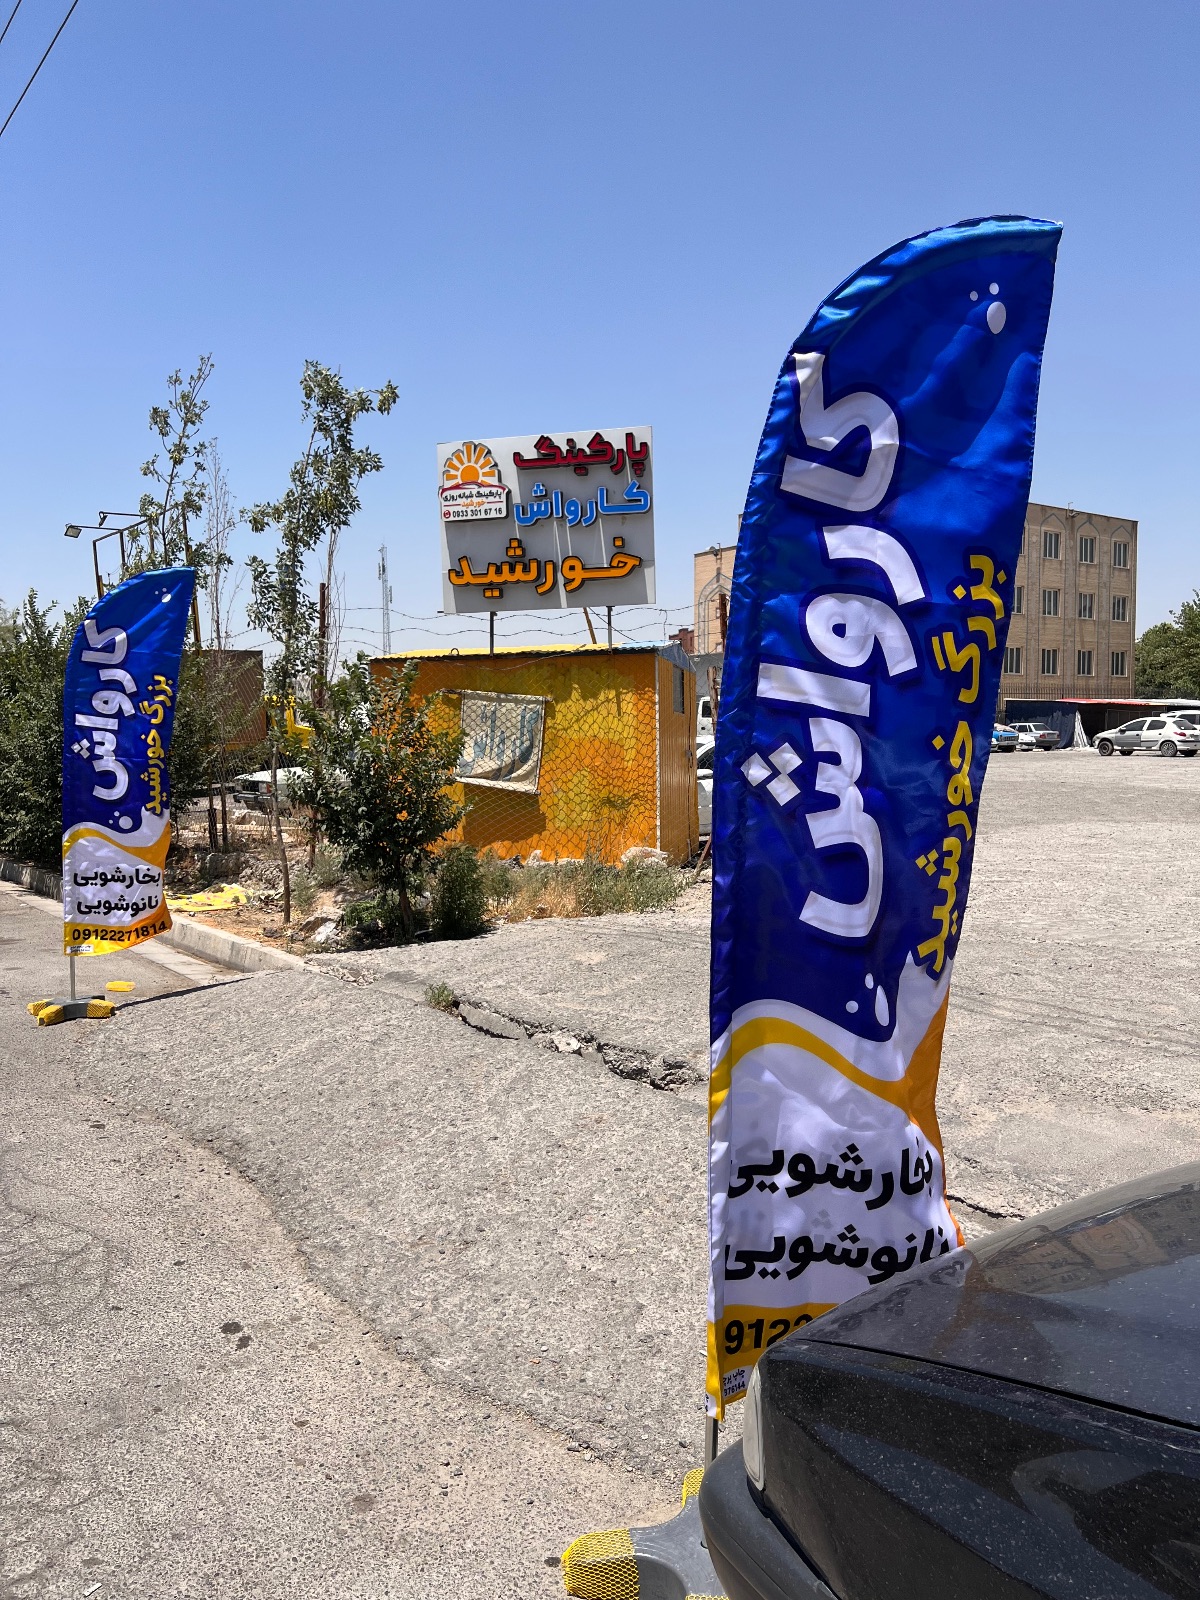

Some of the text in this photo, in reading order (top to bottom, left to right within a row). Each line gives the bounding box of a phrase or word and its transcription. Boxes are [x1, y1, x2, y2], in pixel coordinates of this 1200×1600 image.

[512, 432, 649, 477] پارکینگ
[452, 507, 503, 518] 0933 301 67 16
[461, 499, 486, 508] خورشید
[475, 490, 502, 499] پارکینگ
[513, 480, 651, 528] کارواش
[448, 536, 643, 599] خورشید
[742, 352, 924, 939] کارواش
[71, 619, 138, 800] کارواش
[139, 674, 173, 815] بزرگ خورشید
[915, 554, 1007, 973] بزرگ خورشید
[73, 866, 161, 889] بخارشویی
[76, 894, 159, 917] نانوشویی
[72, 920, 168, 942] 09122271814
